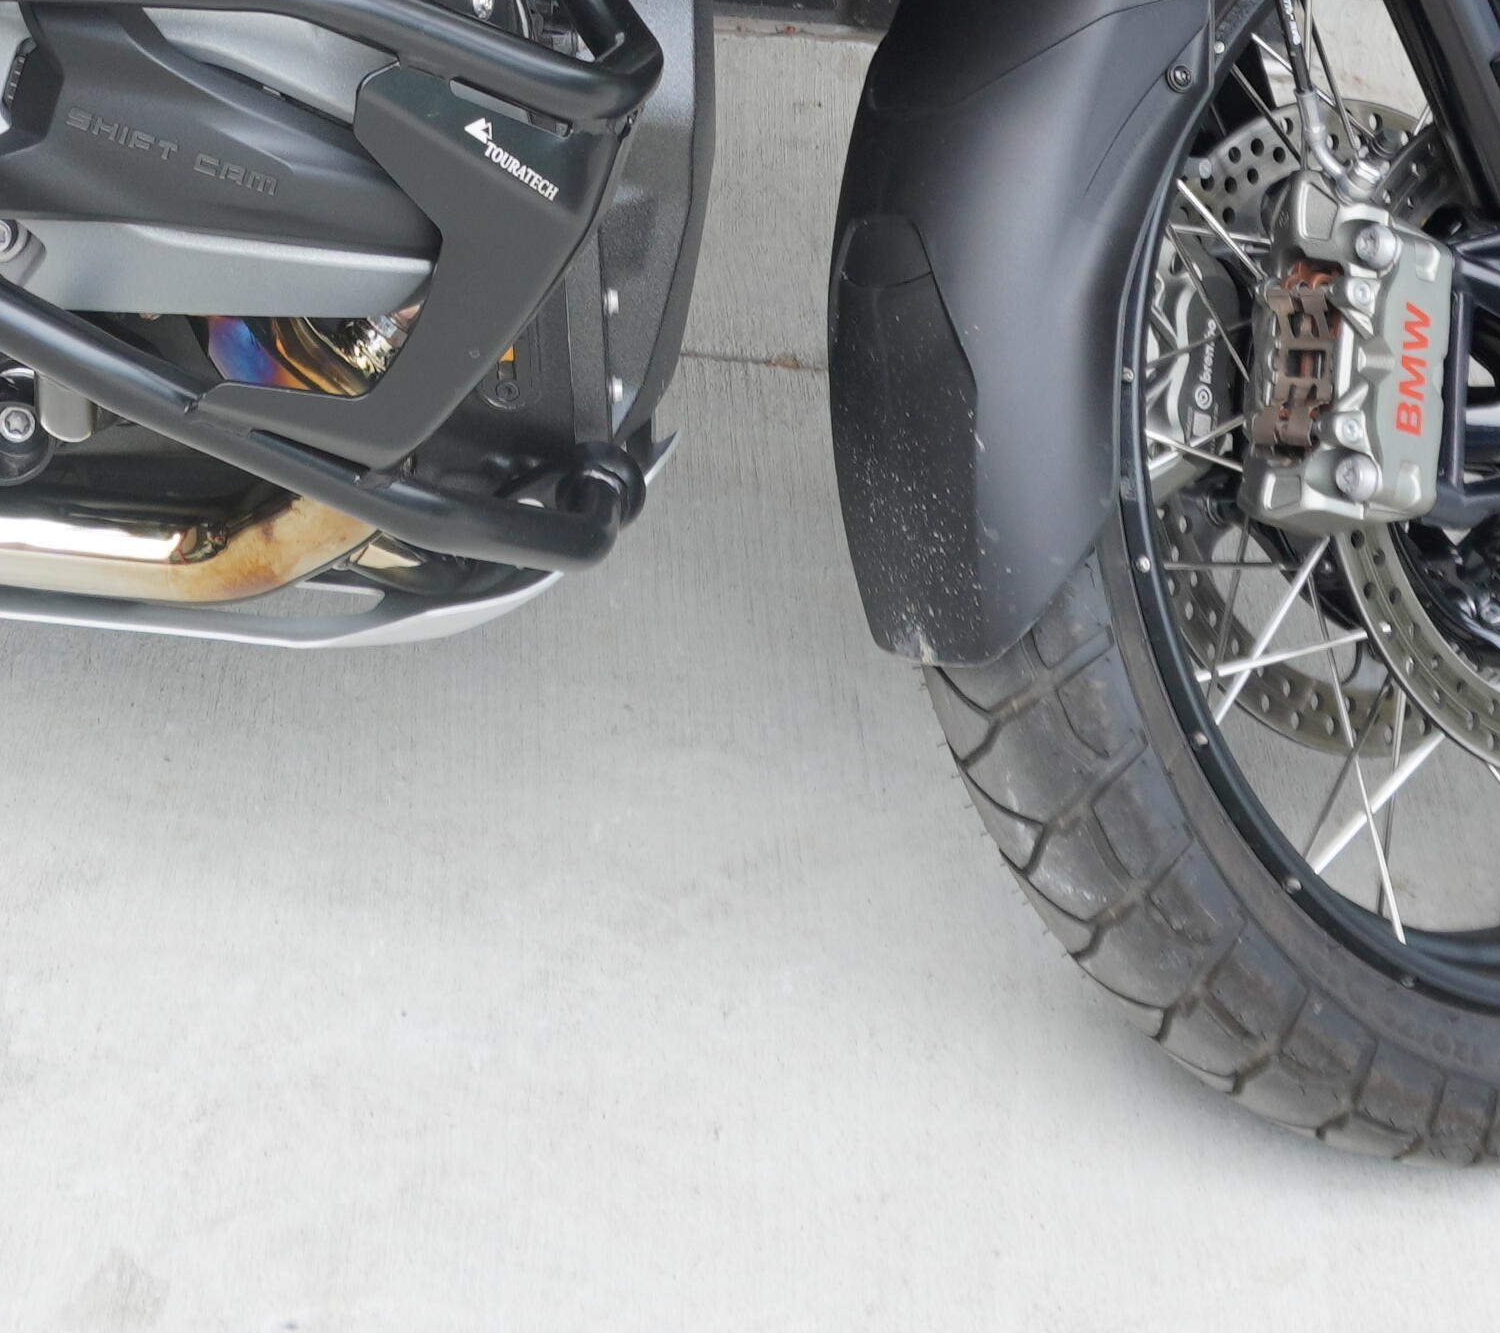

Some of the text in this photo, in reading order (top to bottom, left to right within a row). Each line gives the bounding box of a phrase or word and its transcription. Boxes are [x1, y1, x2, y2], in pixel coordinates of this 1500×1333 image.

[65, 107, 279, 196] SHIFT CAM
[484, 140, 560, 201] TOURATECH
[1200, 318, 1217, 384] brembo
[1395, 301, 1432, 436] BMW
